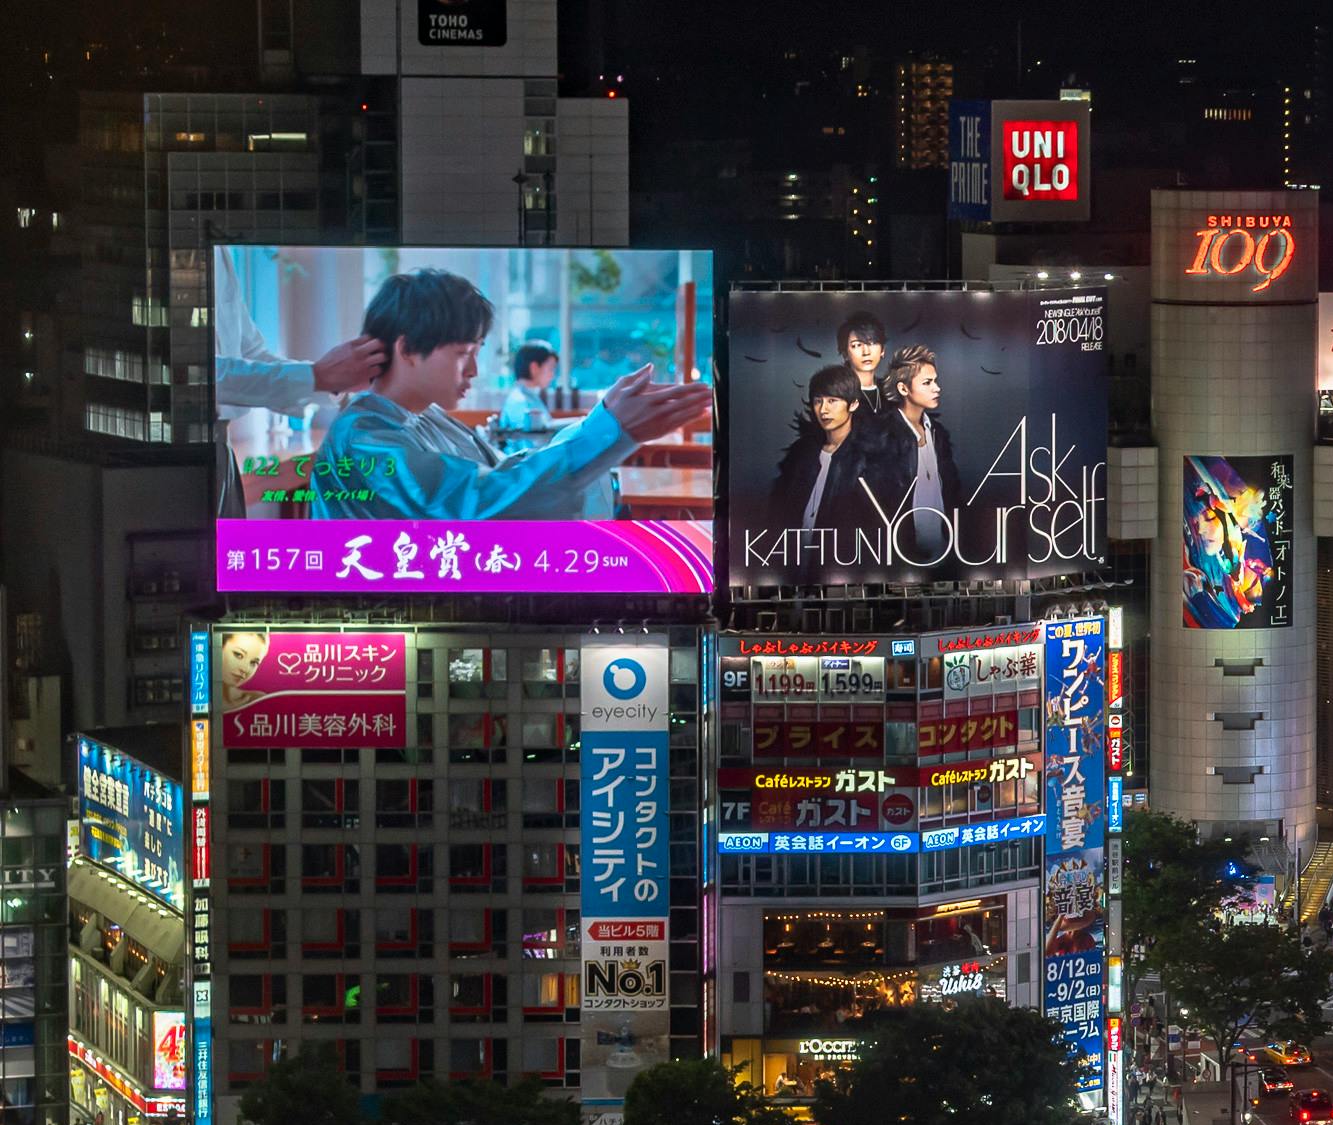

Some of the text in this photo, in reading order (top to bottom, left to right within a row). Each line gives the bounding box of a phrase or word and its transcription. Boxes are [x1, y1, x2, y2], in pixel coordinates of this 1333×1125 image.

[429, 14, 468, 28] TOHO
[428, 29, 484, 40] CINEMAS
[959, 116, 981, 159] THE
[1011, 130, 1065, 158] UNI
[951, 160, 989, 207] PRIME
[1011, 163, 1070, 195] QLO
[1207, 216, 1292, 228] SHIBUYA
[1185, 228, 1296, 293] 109
[1036, 316, 1104, 345] 2018/04/18
[1081, 342, 1103, 351] RELEASE
[242, 454, 279, 477] #22
[967, 413, 1078, 507] Ask
[743, 460, 1106, 569] KAT-TUN Yourself
[226, 549, 323, 572] 第157回
[534, 550, 599, 574] 4.29
[602, 555, 628, 567] SUN
[303, 643, 397, 663] 品川スキン
[739, 639, 879, 655] しゃぶしゃぶバイキング
[937, 629, 1041, 653] しゃぶしゃぶバイキング
[304, 665, 387, 683] クリニック
[975, 651, 1037, 682] しゃぶ葉
[724, 671, 748, 688] 9F
[250, 713, 396, 737] 品川美容外科
[591, 704, 657, 722] eyecity
[754, 725, 878, 749] プライス
[919, 715, 1014, 748] コンタクト
[835, 769, 896, 793] ガスト
[989, 757, 1034, 783] ガスト
[722, 801, 749, 821] 7F
[795, 799, 871, 827] ガスト
[591, 747, 625, 903] アイシティ
[635, 746, 658, 902] コンタクトの
[961, 818, 1045, 843] 英会話イーオン
[723, 835, 763, 849] AEON
[774, 835, 886, 851] 英会話イーオン
[926, 833, 954, 847] AEON
[598, 924, 660, 938] 当ビル5階
[600, 946, 650, 957] 利用者数
[585, 960, 666, 997] No.1
[1047, 957, 1101, 981] 8/12(日)
[939, 973, 983, 995] Ushi8
[584, 999, 666, 1009] コンタクトショップ
